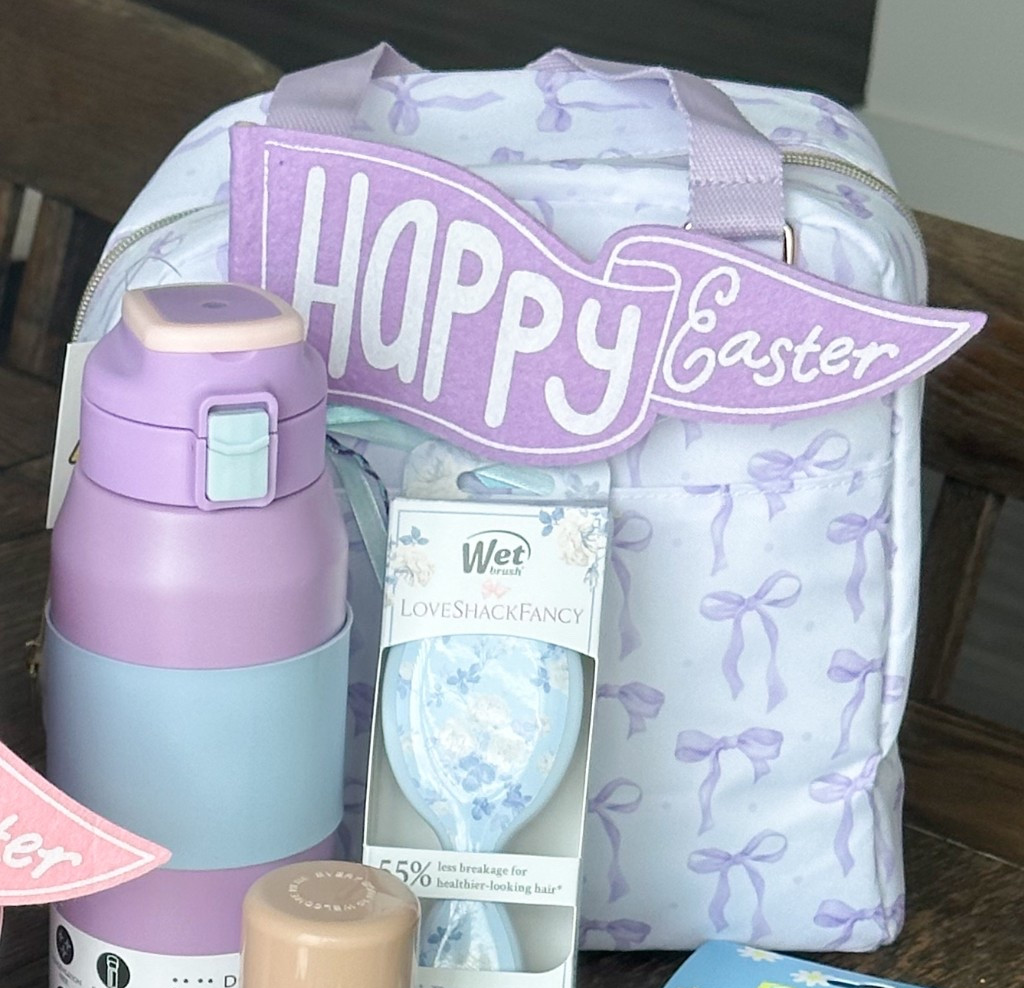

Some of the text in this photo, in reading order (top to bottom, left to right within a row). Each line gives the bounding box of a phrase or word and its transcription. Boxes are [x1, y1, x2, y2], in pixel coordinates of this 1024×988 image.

[663, 265, 899, 393] Easter
[462, 538, 526, 574] Wet
[489, 566, 522, 577] brush
[437, 862, 457, 873] less
[459, 862, 509, 877] breakage
[511, 865, 528, 877] for
[436, 877, 532, 895] healthier-looking
